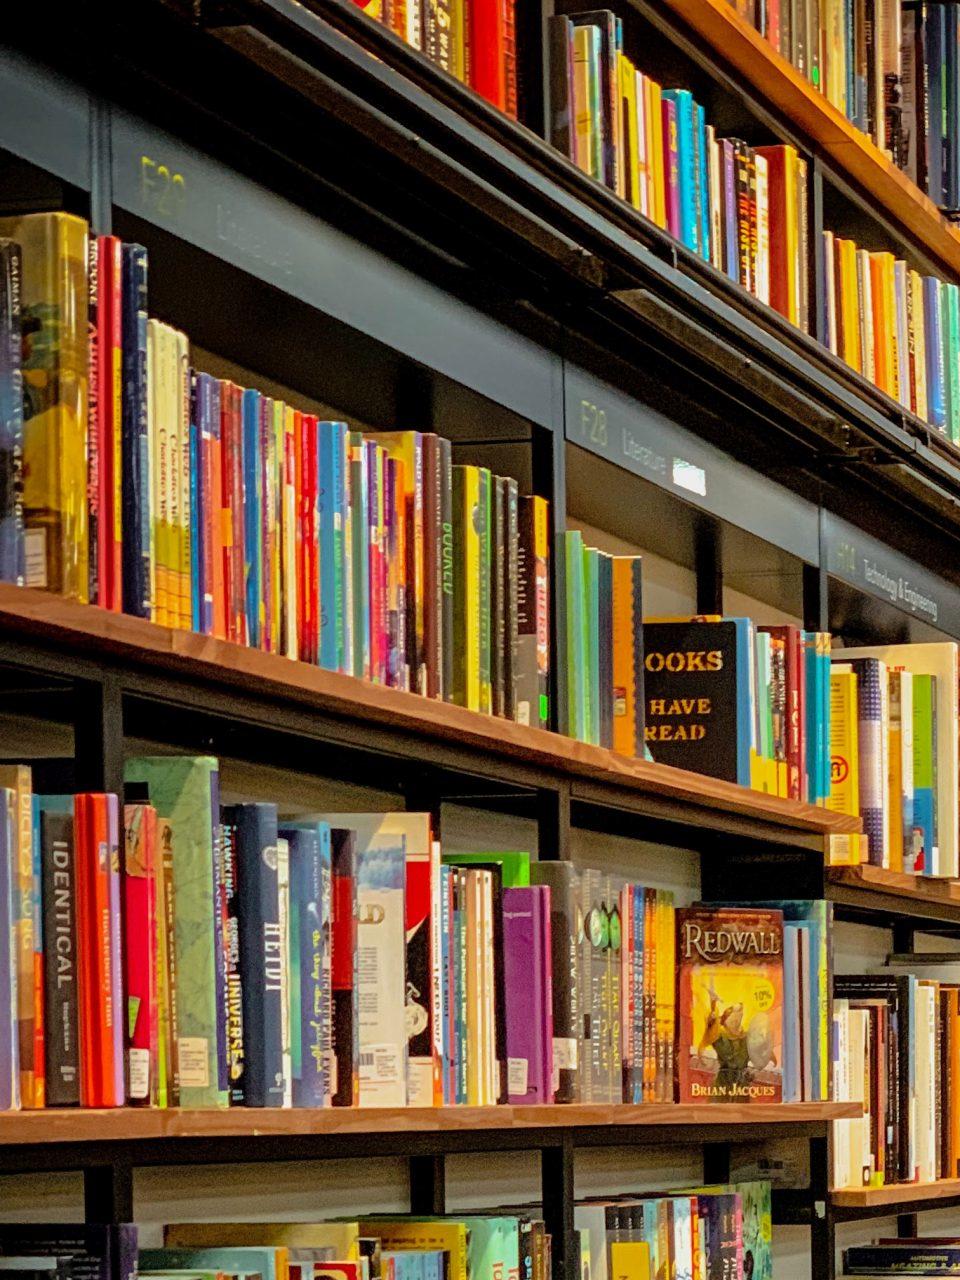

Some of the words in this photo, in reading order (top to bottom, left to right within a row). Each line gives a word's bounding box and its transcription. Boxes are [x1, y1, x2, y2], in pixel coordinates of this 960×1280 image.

[650, 699, 711, 715] HAVE
[223, 825, 233, 899] HAWKING
[52, 840, 73, 988] IDENTICAL
[264, 922, 281, 992] HEIDI
[685, 923, 780, 961] REDWALL
[321, 968, 331, 1020] RICHARD
[754, 989, 773, 1002] 10%
[691, 1083, 726, 1096] BRIAN
[728, 1082, 775, 1096] JACQUES
